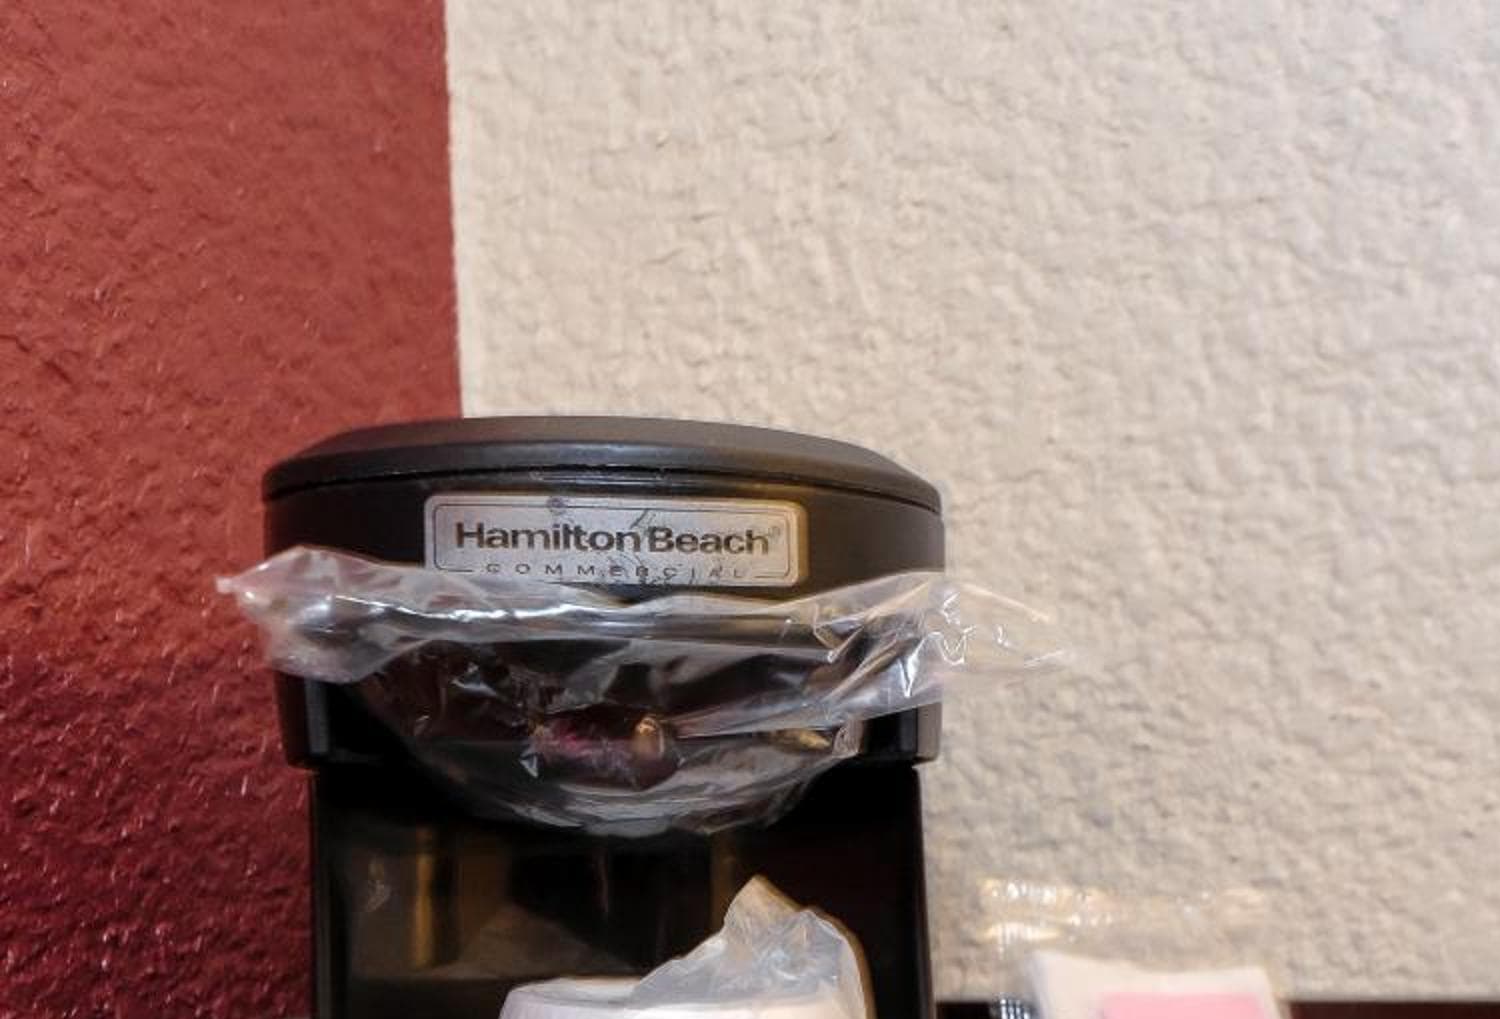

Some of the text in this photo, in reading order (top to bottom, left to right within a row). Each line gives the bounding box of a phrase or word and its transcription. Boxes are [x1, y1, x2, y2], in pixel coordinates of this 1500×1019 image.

[456, 522, 770, 556] Hamilton Beach
[485, 562, 744, 579] COMMERCIAL
